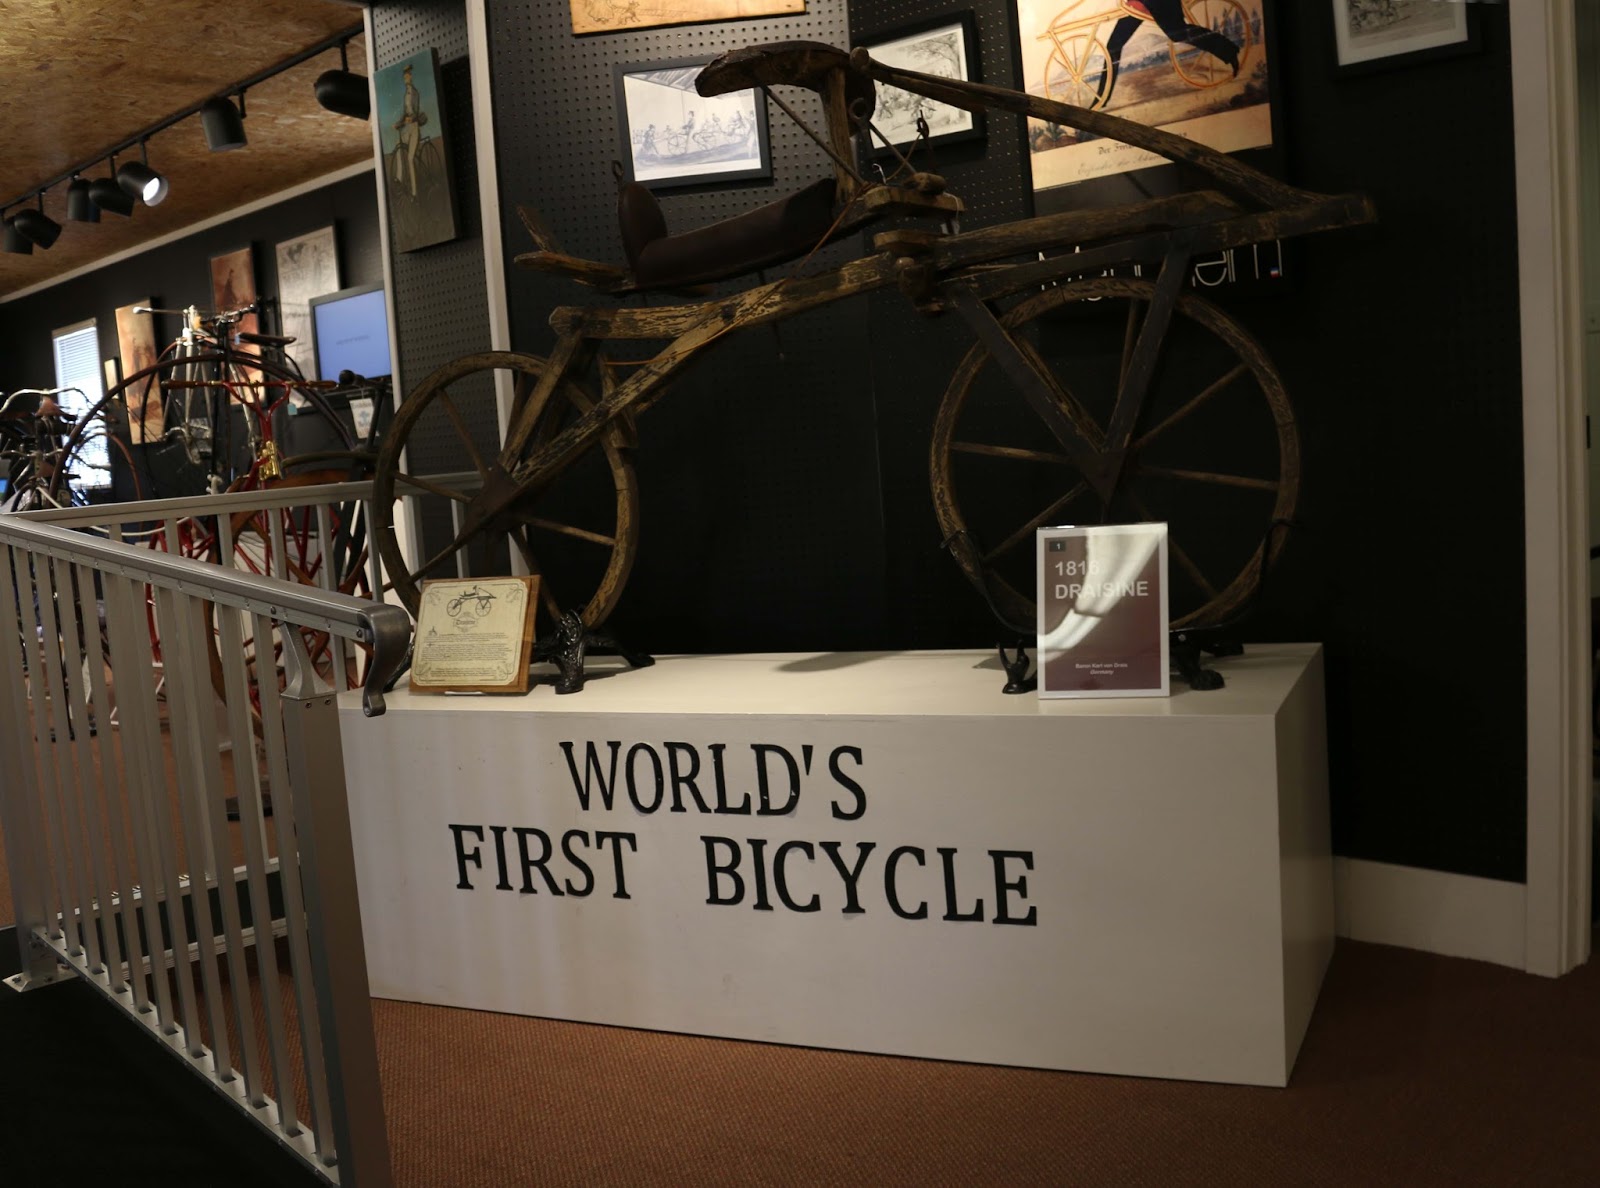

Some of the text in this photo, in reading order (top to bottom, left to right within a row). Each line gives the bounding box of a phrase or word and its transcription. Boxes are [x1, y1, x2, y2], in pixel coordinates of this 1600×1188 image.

[1055, 581, 1149, 599] DRAISINE
[559, 740, 868, 821] WORLD'S
[448, 823, 1037, 927] FIRST BICYCLE
